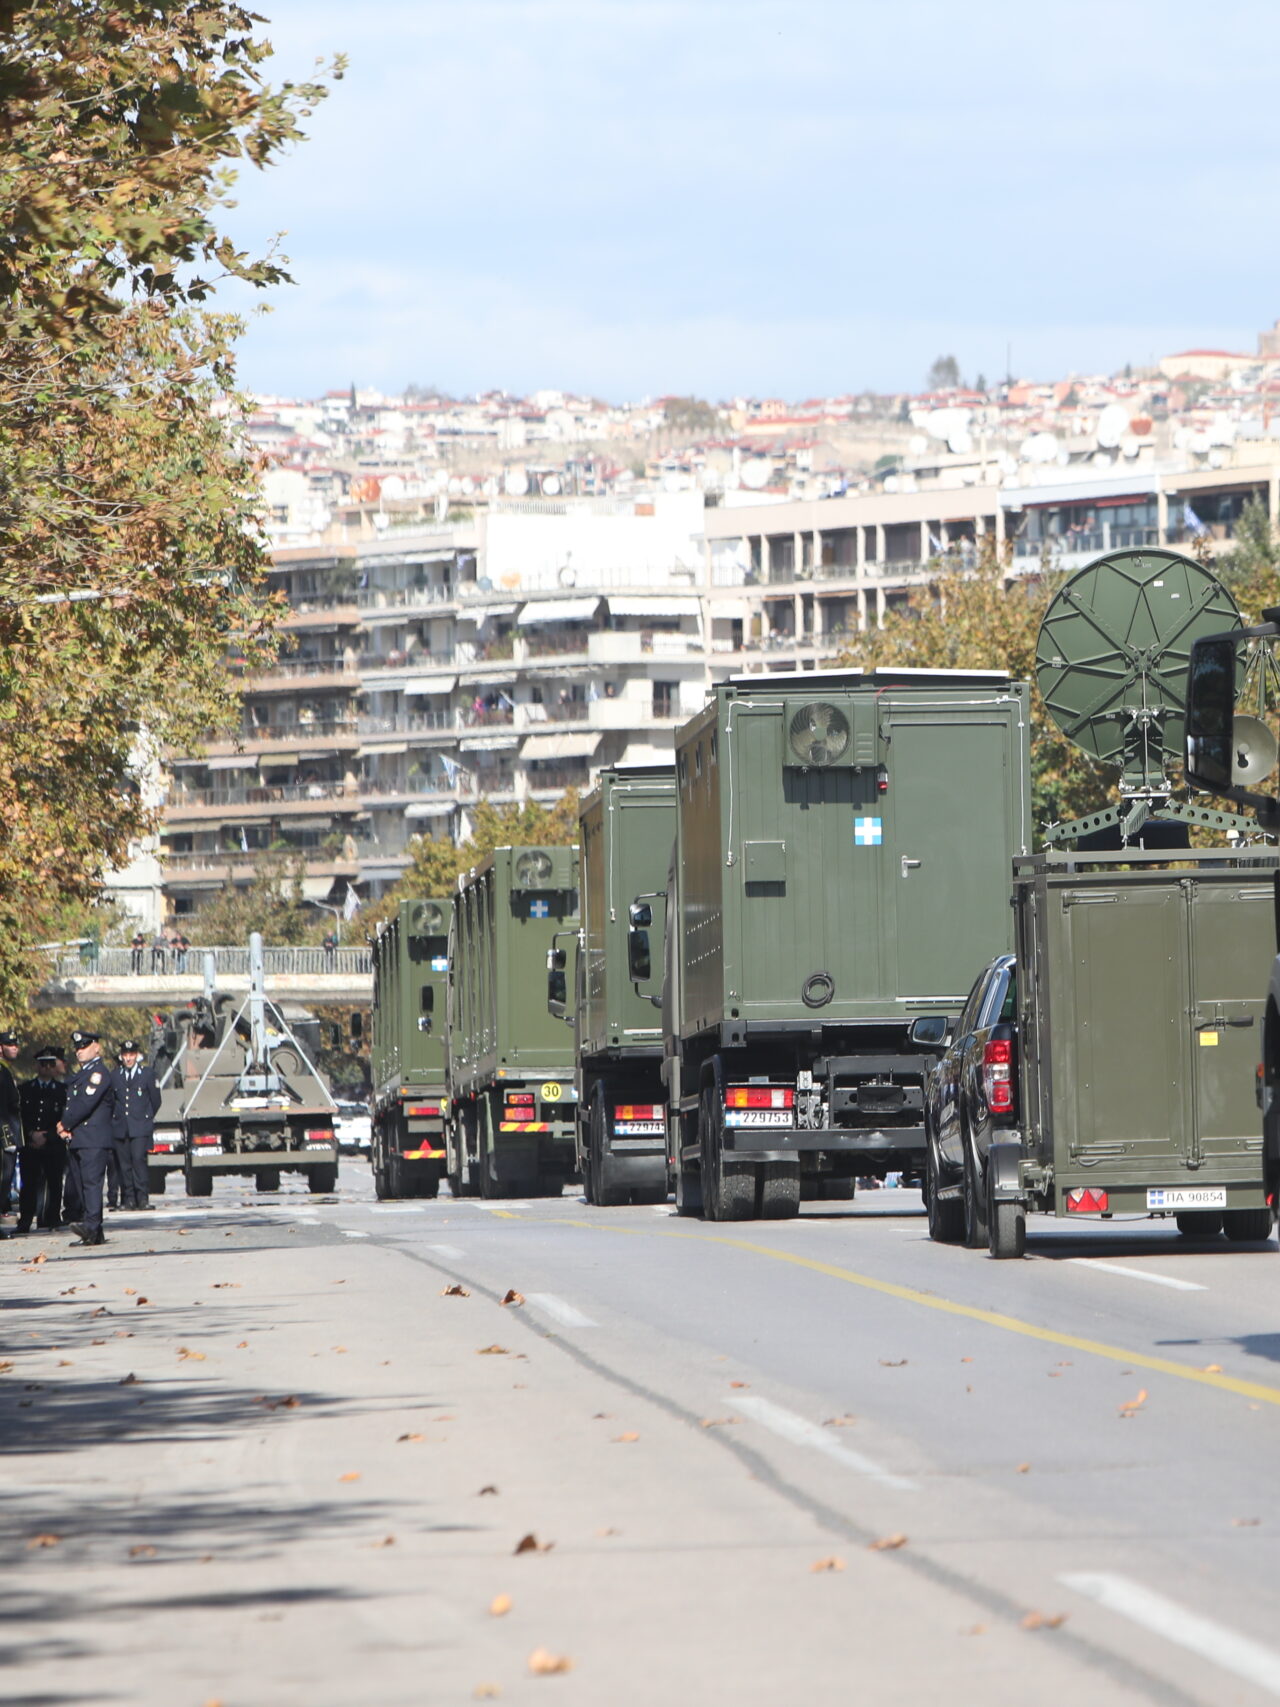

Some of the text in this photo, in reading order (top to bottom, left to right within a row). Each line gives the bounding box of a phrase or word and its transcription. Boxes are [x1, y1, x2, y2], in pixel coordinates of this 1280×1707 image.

[543, 1085, 559, 1097] 30
[743, 1112, 789, 1124] 229753
[1189, 1192, 1223, 1201] 90854
